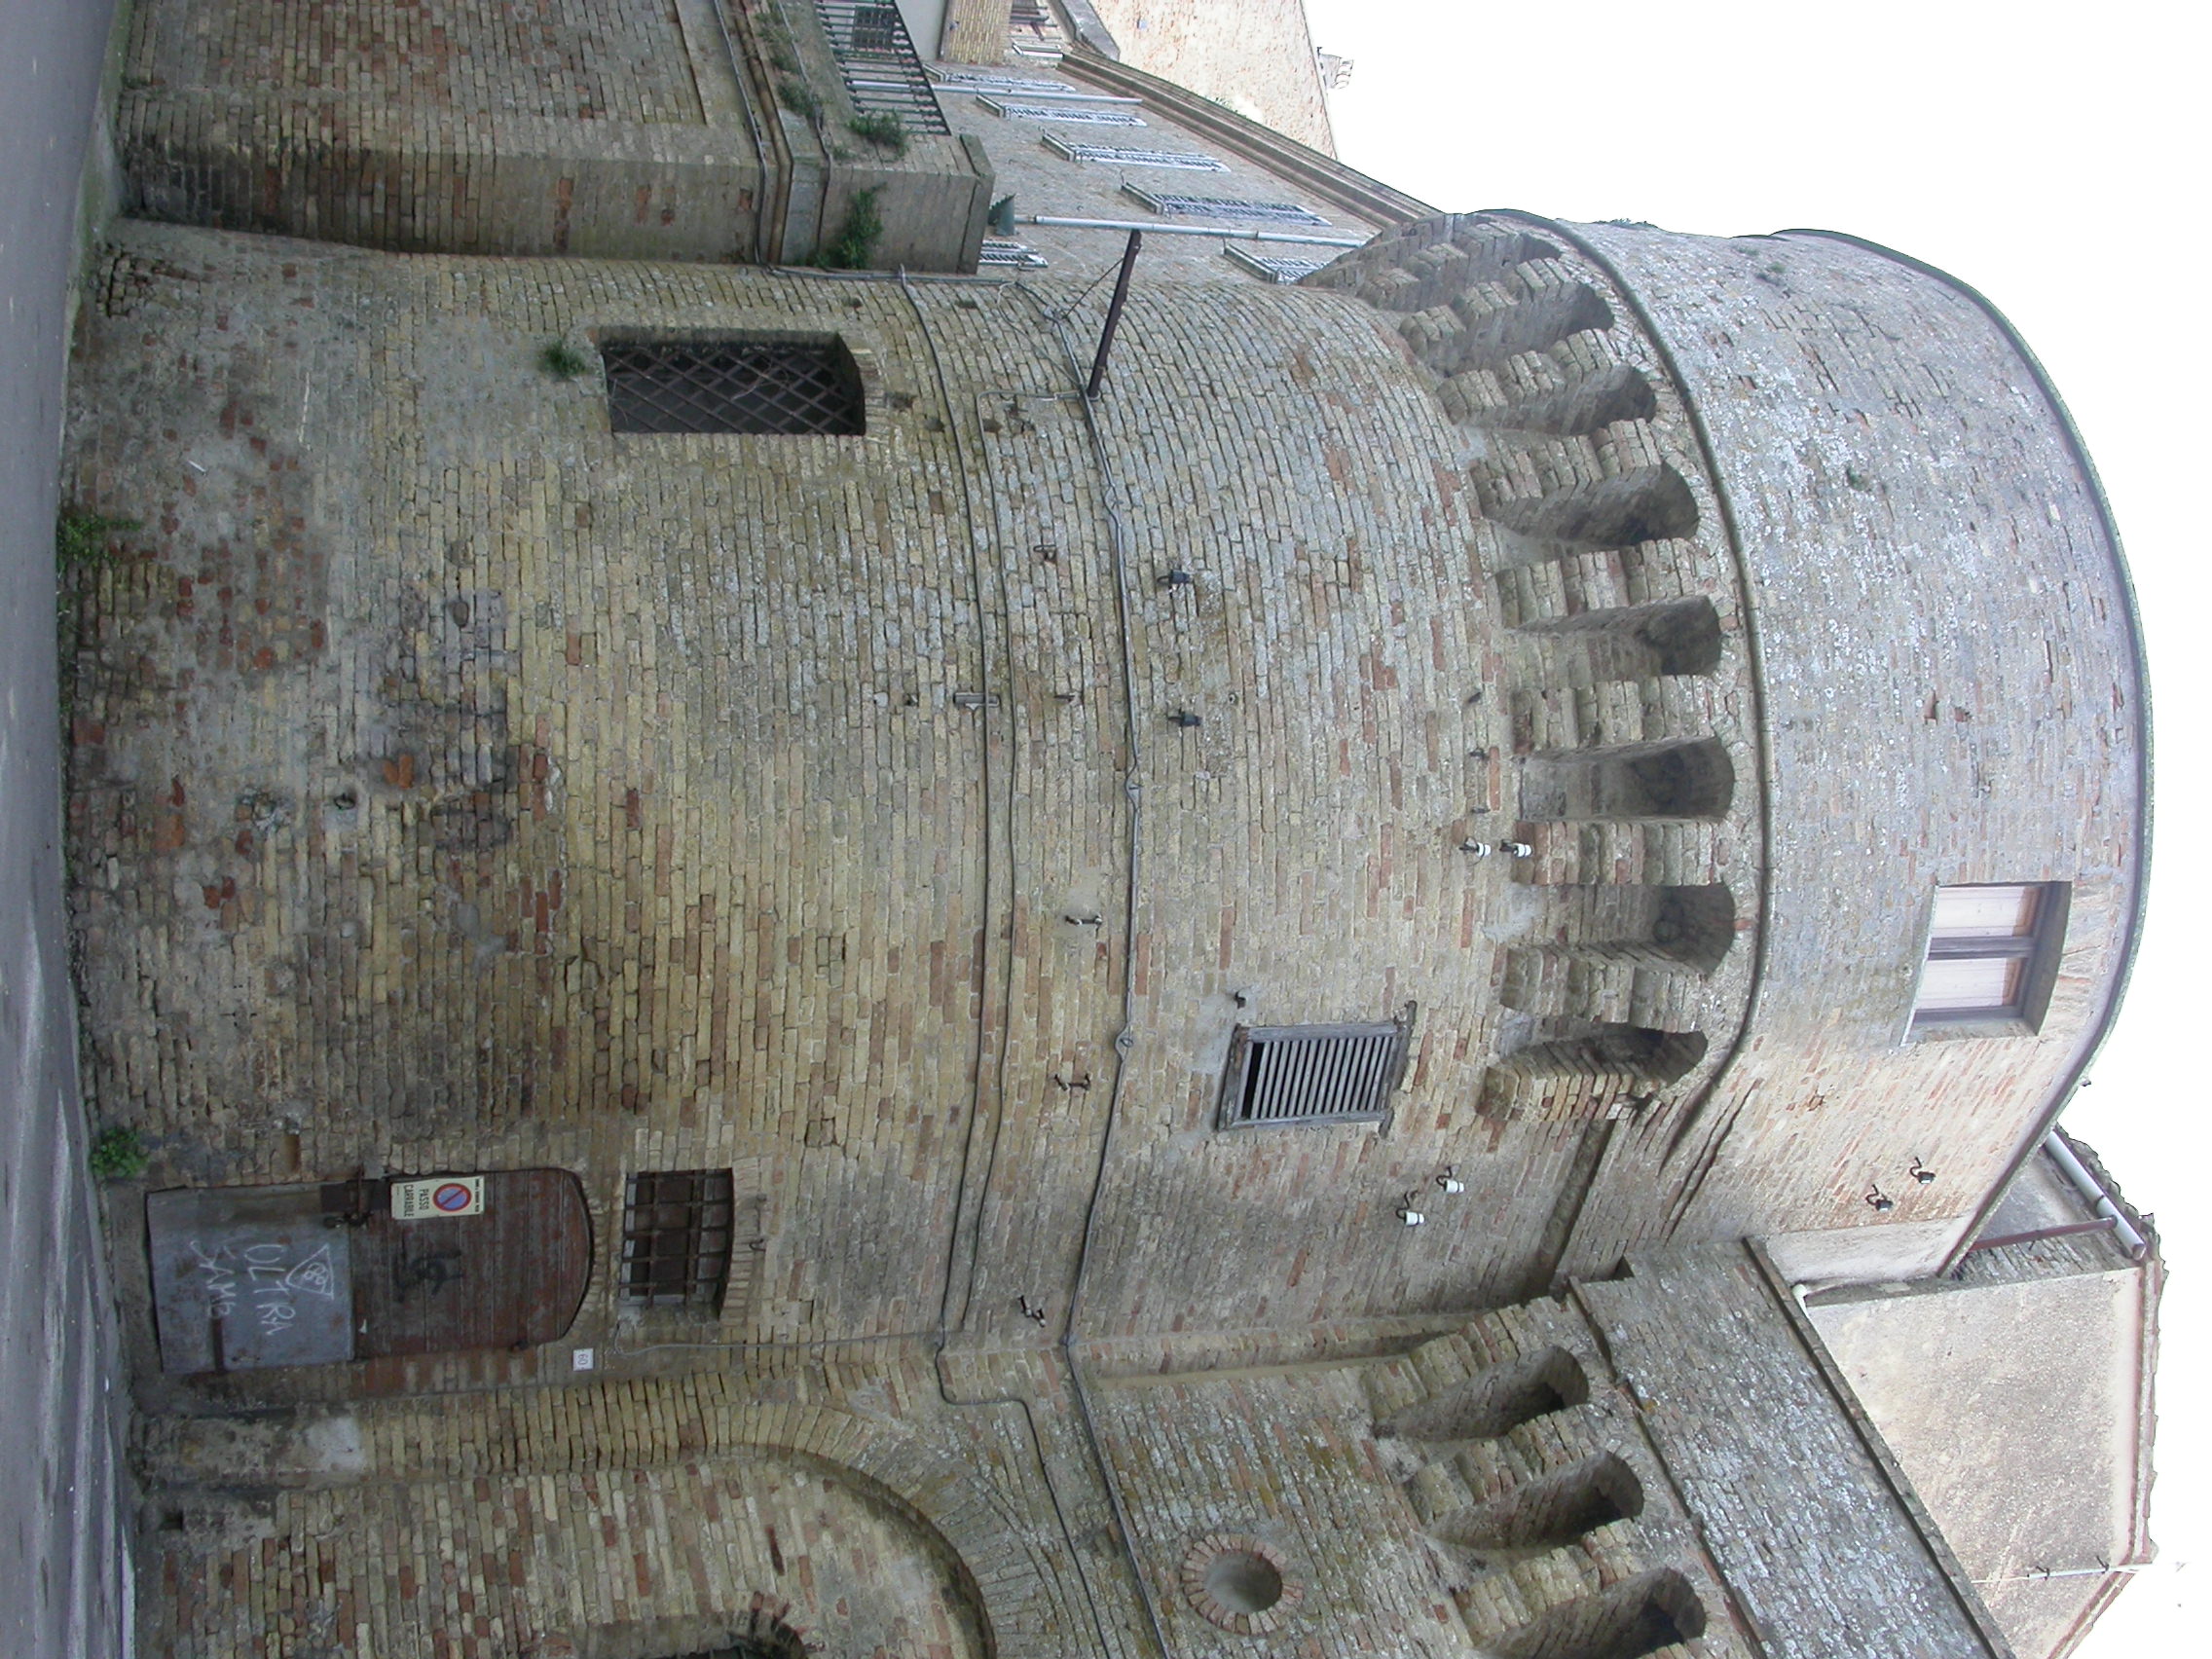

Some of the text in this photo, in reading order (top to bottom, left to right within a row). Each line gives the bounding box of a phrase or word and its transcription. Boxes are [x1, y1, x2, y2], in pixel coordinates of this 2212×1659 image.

[403, 1184, 415, 1217] CARRABILE
[419, 1188, 429, 1210] PASSO
[243, 1243, 296, 1336] ULTRA
